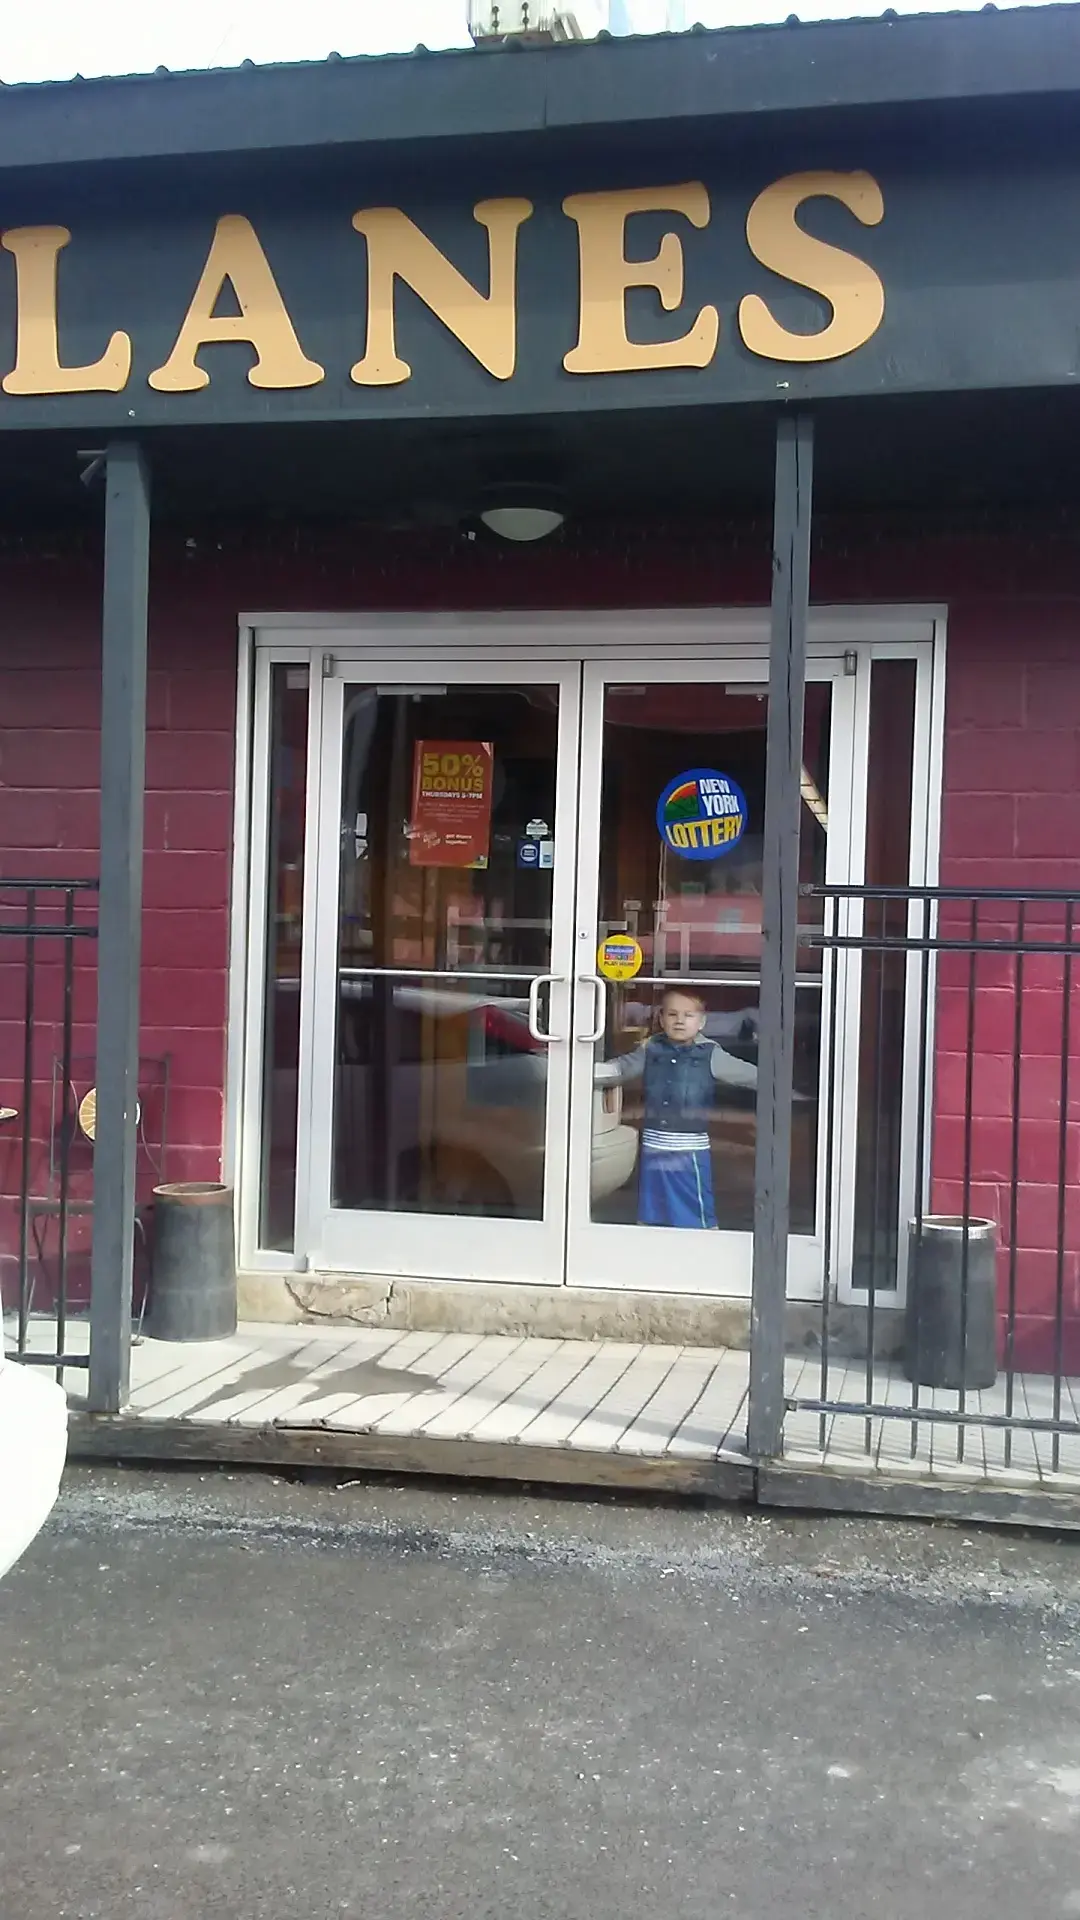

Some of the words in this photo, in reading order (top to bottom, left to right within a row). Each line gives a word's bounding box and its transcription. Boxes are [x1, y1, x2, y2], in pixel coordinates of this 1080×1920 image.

[2, 170, 885, 395] LANES
[423, 753, 484, 777] 50%
[422, 775, 484, 791] BONUS
[699, 778, 730, 794] NEW
[422, 791, 460, 799] THURSDAYS
[701, 794, 740, 816] YORK
[665, 814, 743, 848] LOTTERY
